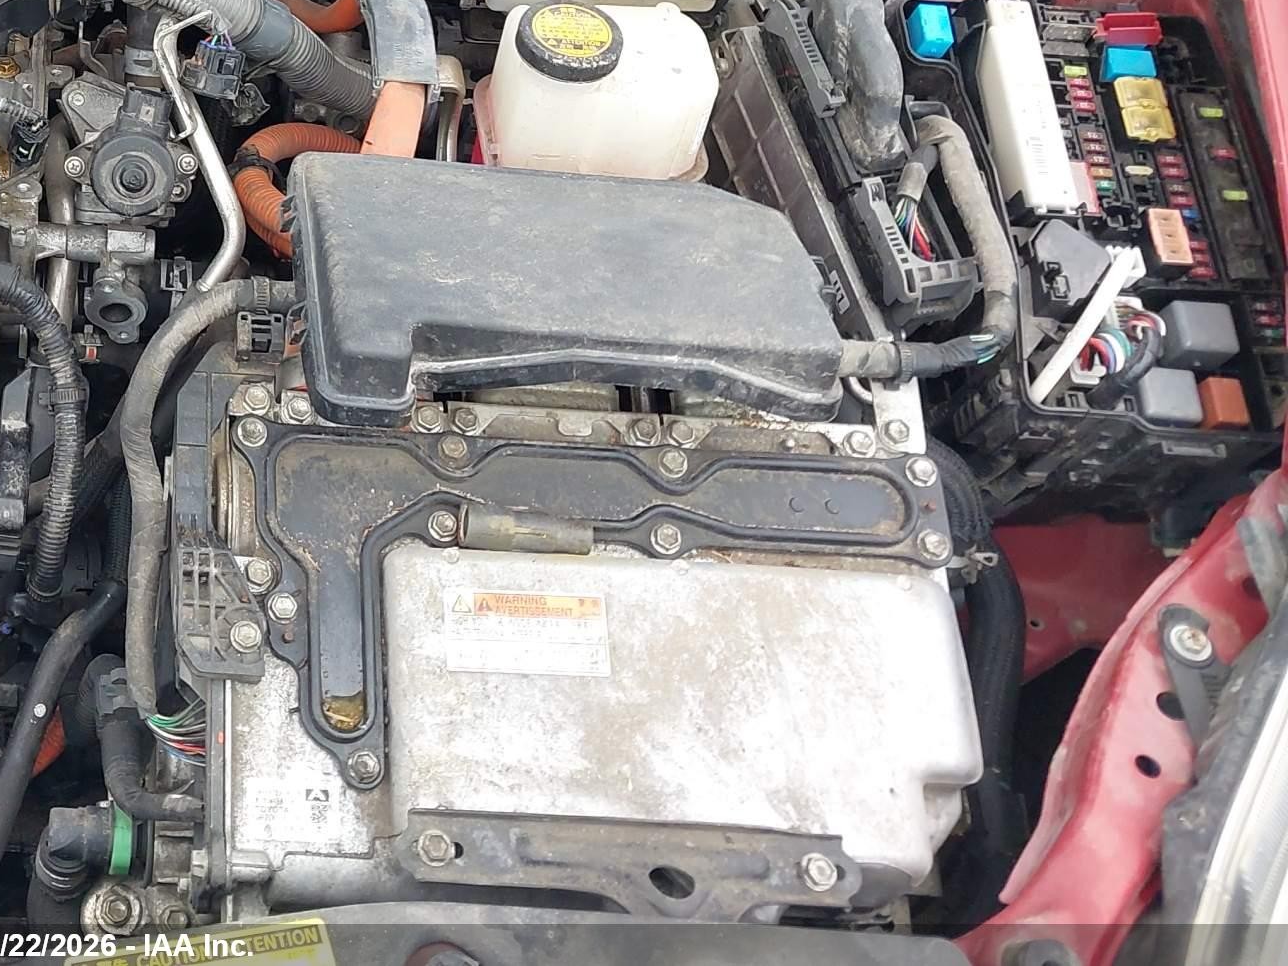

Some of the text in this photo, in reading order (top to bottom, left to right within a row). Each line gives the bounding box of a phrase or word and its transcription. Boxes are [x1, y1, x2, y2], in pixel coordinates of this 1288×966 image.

[494, 594, 547, 606] WARNING
[494, 605, 573, 617] AVERTISSEMENT
[226, 926, 320, 953] TENTION
